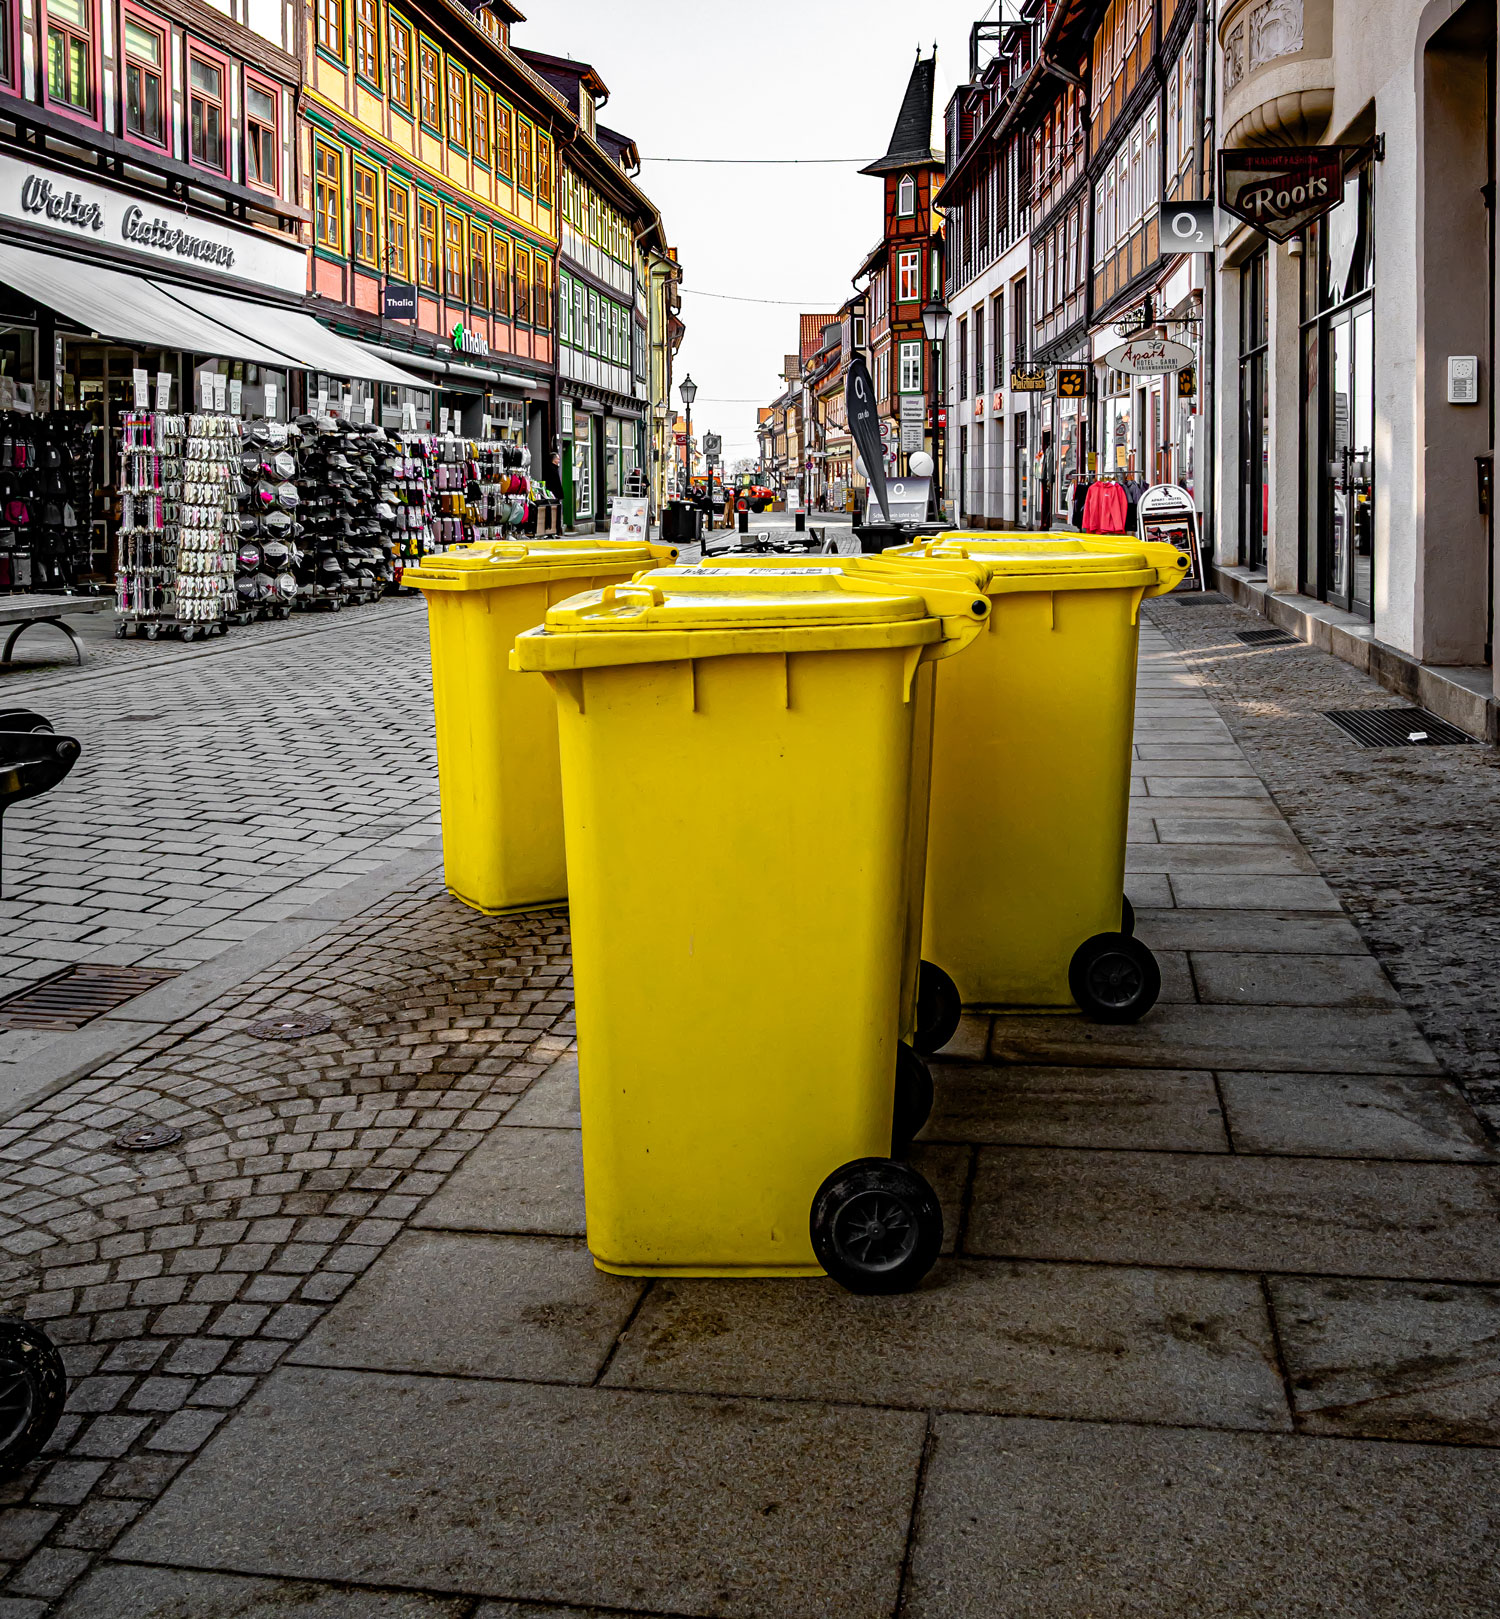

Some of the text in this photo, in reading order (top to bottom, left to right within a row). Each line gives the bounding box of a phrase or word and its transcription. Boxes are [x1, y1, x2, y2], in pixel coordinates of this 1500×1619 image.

[1242, 175, 1328, 219] Roots
[21, 174, 236, 269] Walter Gattermann
[386, 298, 414, 307] Thalia
[462, 328, 489, 355] Thalia
[1120, 344, 1166, 367] Apart
